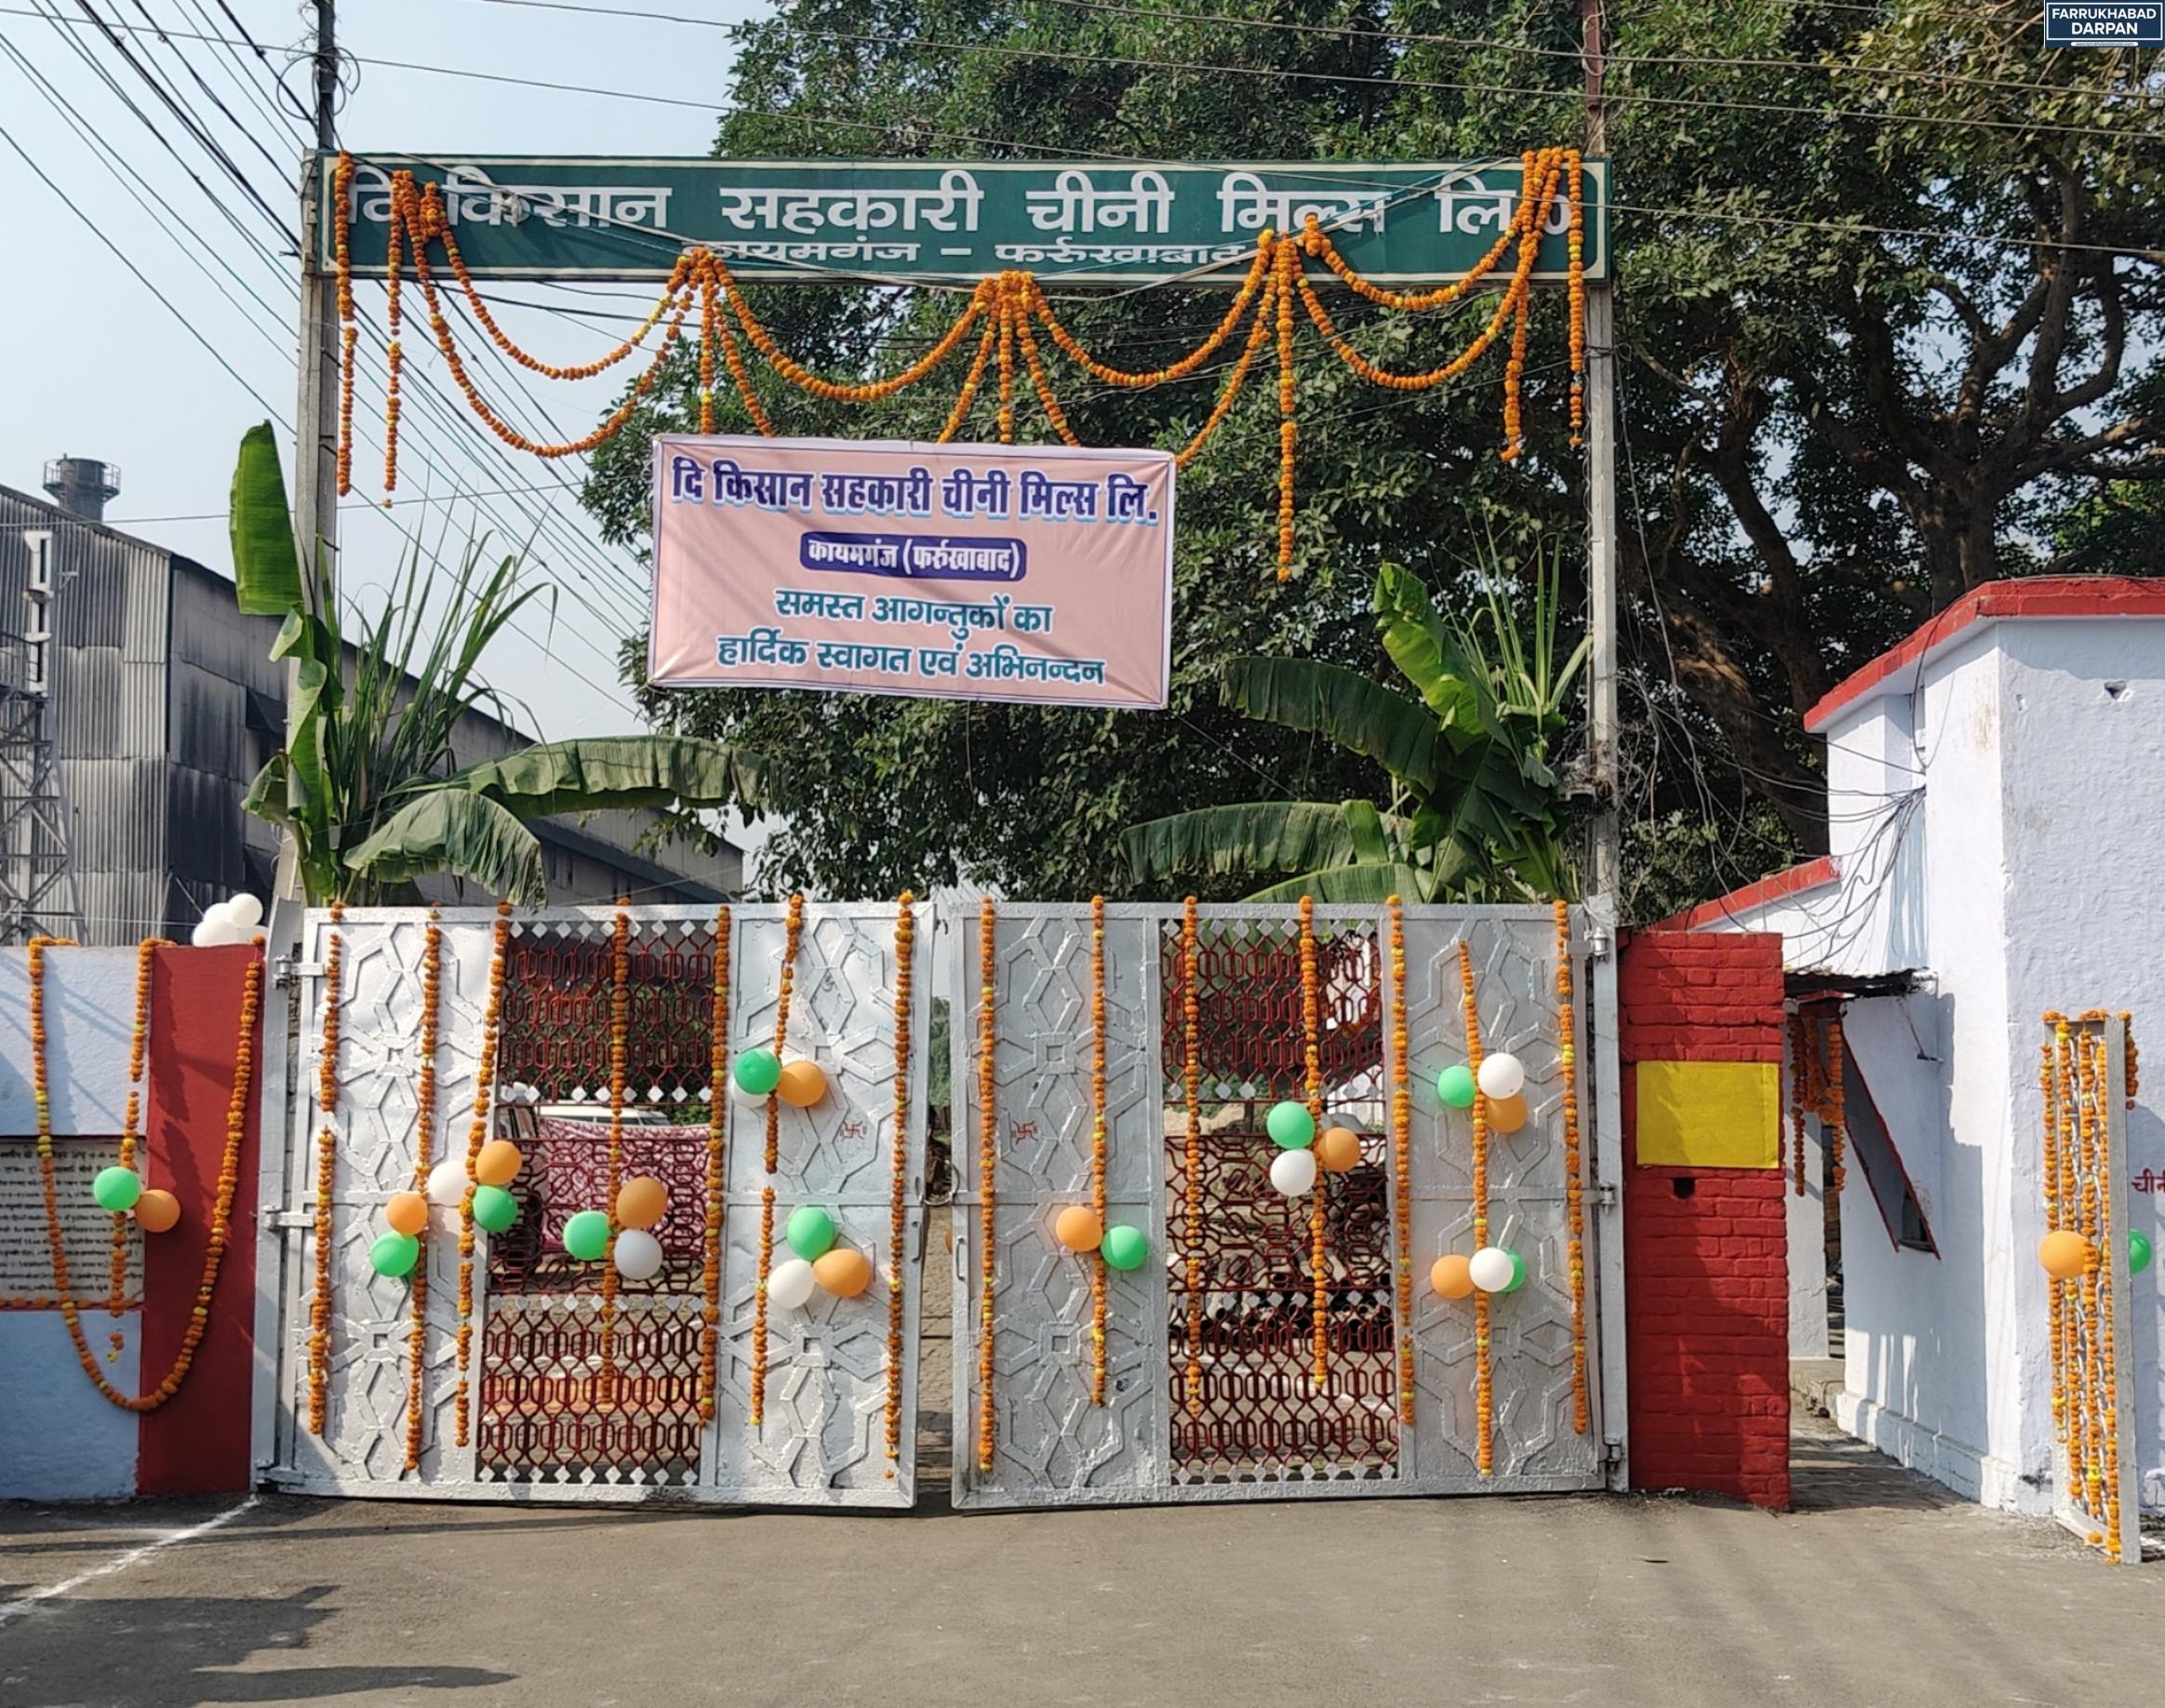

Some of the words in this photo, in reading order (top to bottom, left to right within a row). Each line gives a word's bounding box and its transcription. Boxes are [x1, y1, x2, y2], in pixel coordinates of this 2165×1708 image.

[441, 166, 672, 228] किसान
[719, 169, 984, 234] सहकारी
[1025, 170, 1175, 233] चीनी
[1216, 172, 1392, 234] मिल्स
[672, 455, 705, 500] दि
[712, 459, 815, 508] किसान
[822, 467, 933, 514] सहकारी
[942, 468, 1011, 516] चीनी
[1020, 471, 1100, 518] मिल्स
[1107, 474, 1157, 522] लि.
[808, 537, 900, 568] कायमगंज
[903, 538, 1021, 579] (फर्रुखाबाद)
[775, 590, 866, 620] समस्त
[871, 594, 1010, 642] आगन्तुकों
[1012, 606, 1054, 633] का
[717, 628, 810, 666] हार्दिक
[816, 642, 913, 673] स्वागत
[918, 642, 965, 676] एवं
[965, 644, 1105, 685] अभिनन्दन
[2131, 1168, 2165, 1194] चीन
